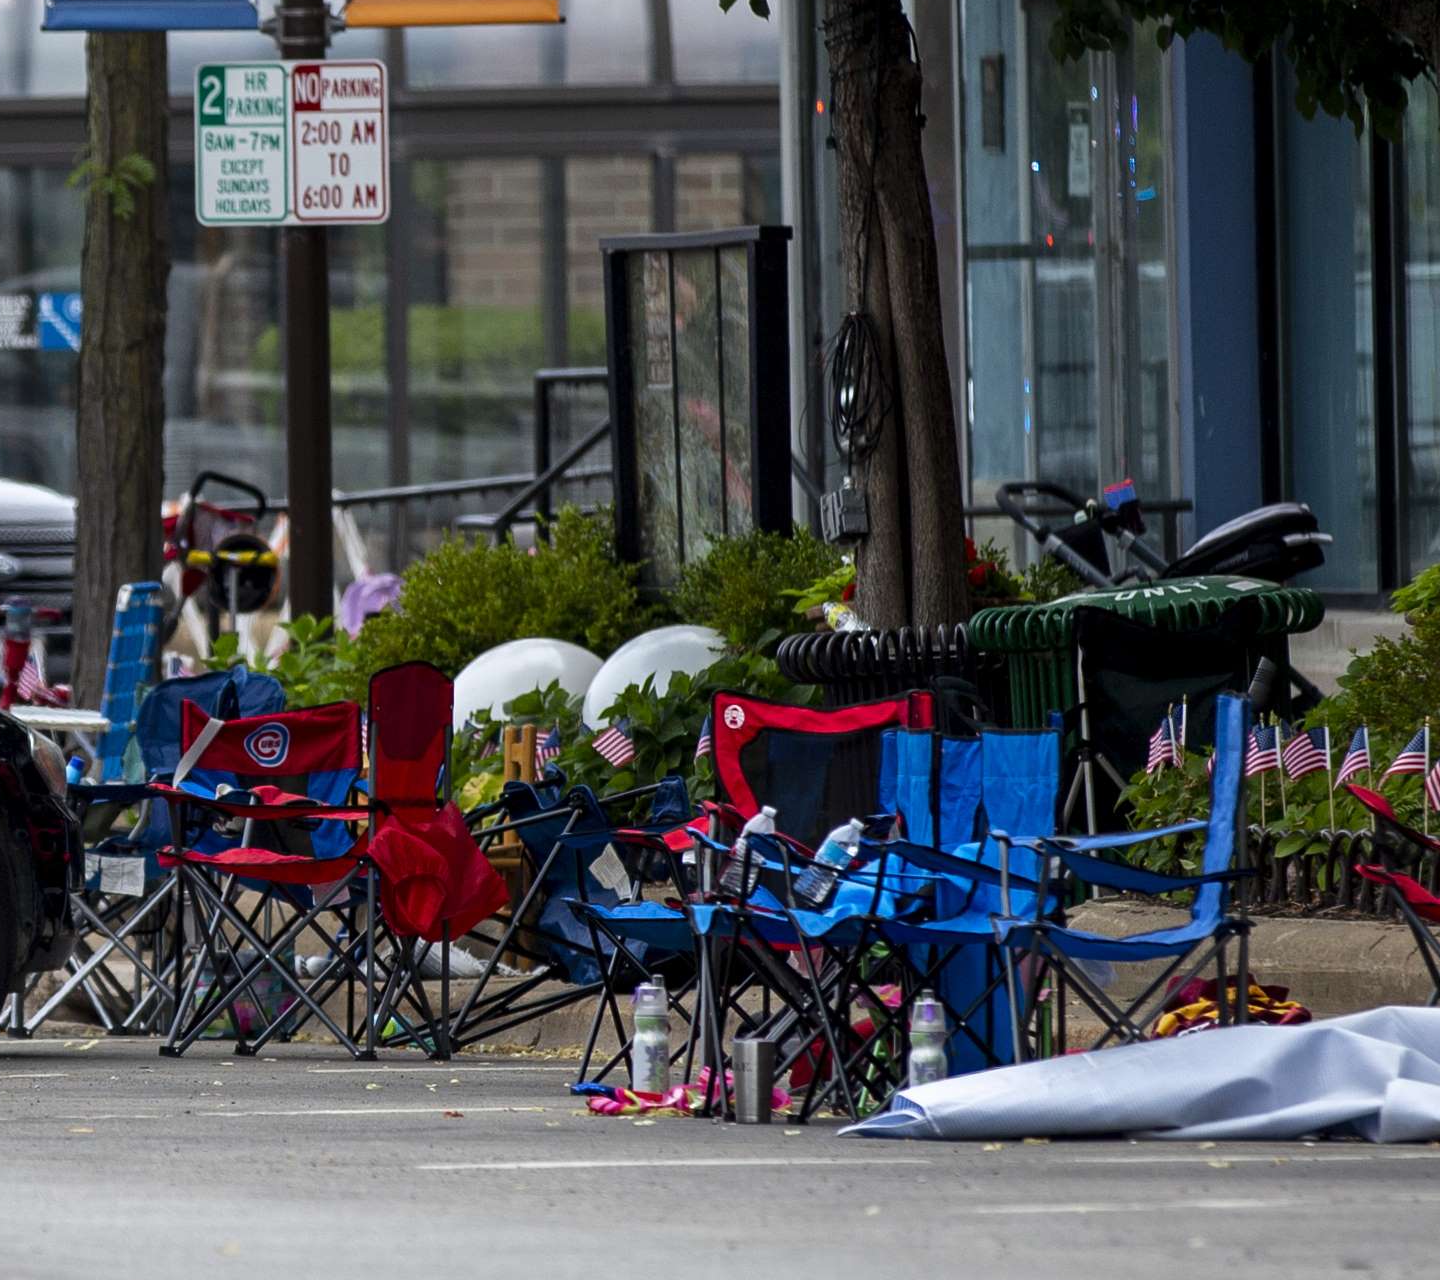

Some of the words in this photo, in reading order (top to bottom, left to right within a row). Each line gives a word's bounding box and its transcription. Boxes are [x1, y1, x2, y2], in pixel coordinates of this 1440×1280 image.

[202, 75, 223, 116] 2
[244, 71, 268, 92] HR
[294, 73, 320, 104] NO
[322, 78, 381, 98] PARKING
[227, 97, 283, 118] PARKING
[301, 121, 341, 145] 2:00
[351, 121, 377, 144] AM
[221, 158, 265, 175] EXCEPT
[328, 151, 350, 176] TO
[217, 178, 270, 195] SUNDAYS
[302, 184, 343, 210] 6:00
[352, 184, 378, 208] AM
[215, 199, 271, 214] HOLIDAYS
[1114, 575, 1209, 602] ONLY
